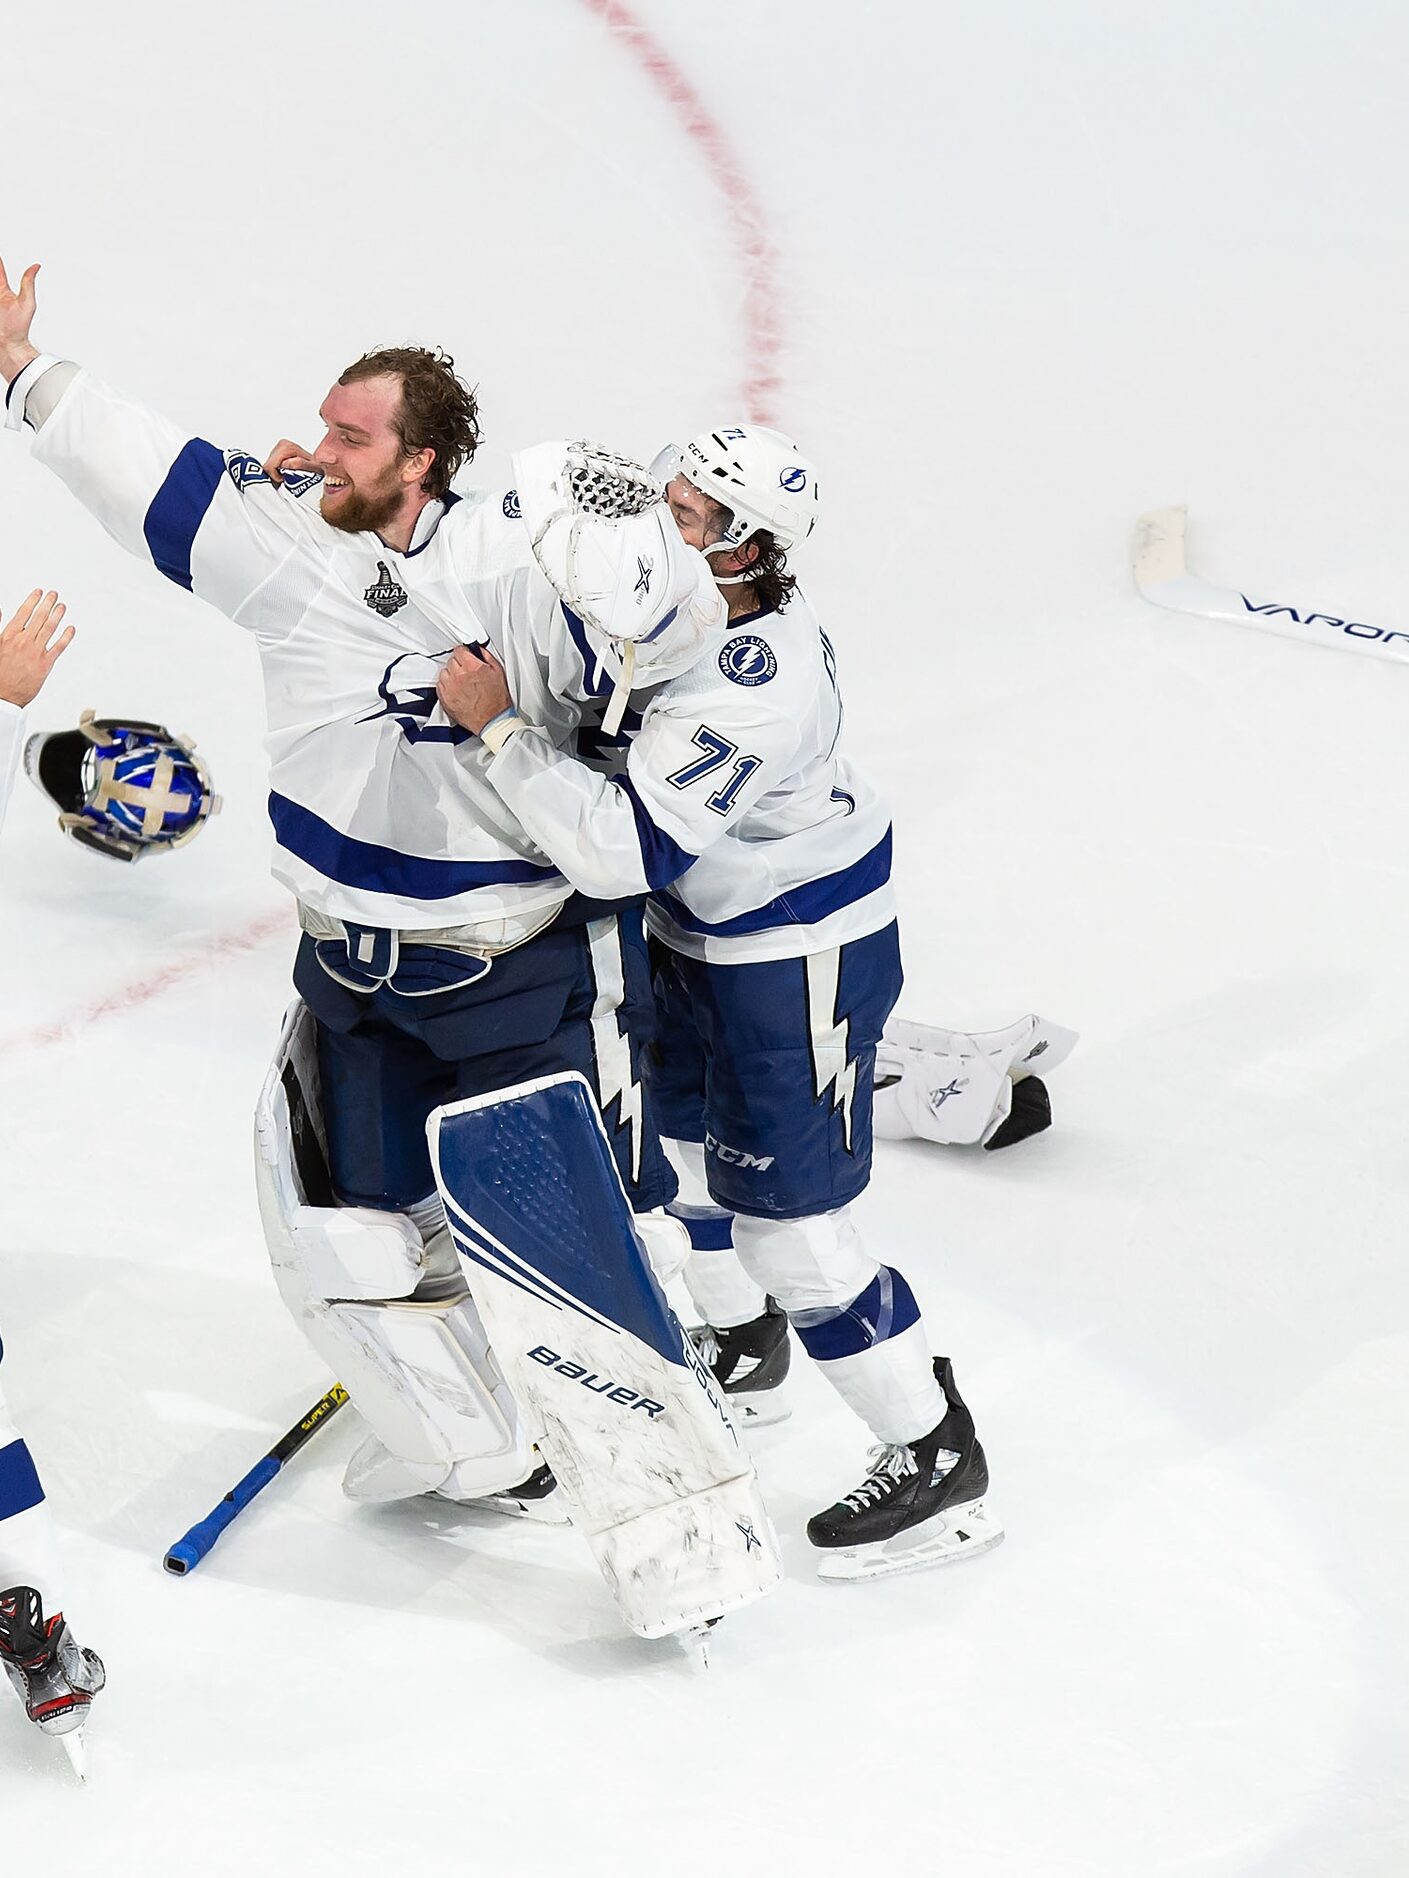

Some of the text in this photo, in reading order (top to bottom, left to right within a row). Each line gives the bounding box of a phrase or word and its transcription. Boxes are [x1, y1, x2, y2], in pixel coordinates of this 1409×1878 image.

[688, 443, 709, 464] CCM
[366, 588, 407, 599] FINAL
[720, 637, 776, 677] TAMPA BAY LIGHTNING
[665, 724, 763, 817] 71
[704, 1130, 775, 1172] CCM
[301, 1401, 331, 1430] SUPER
